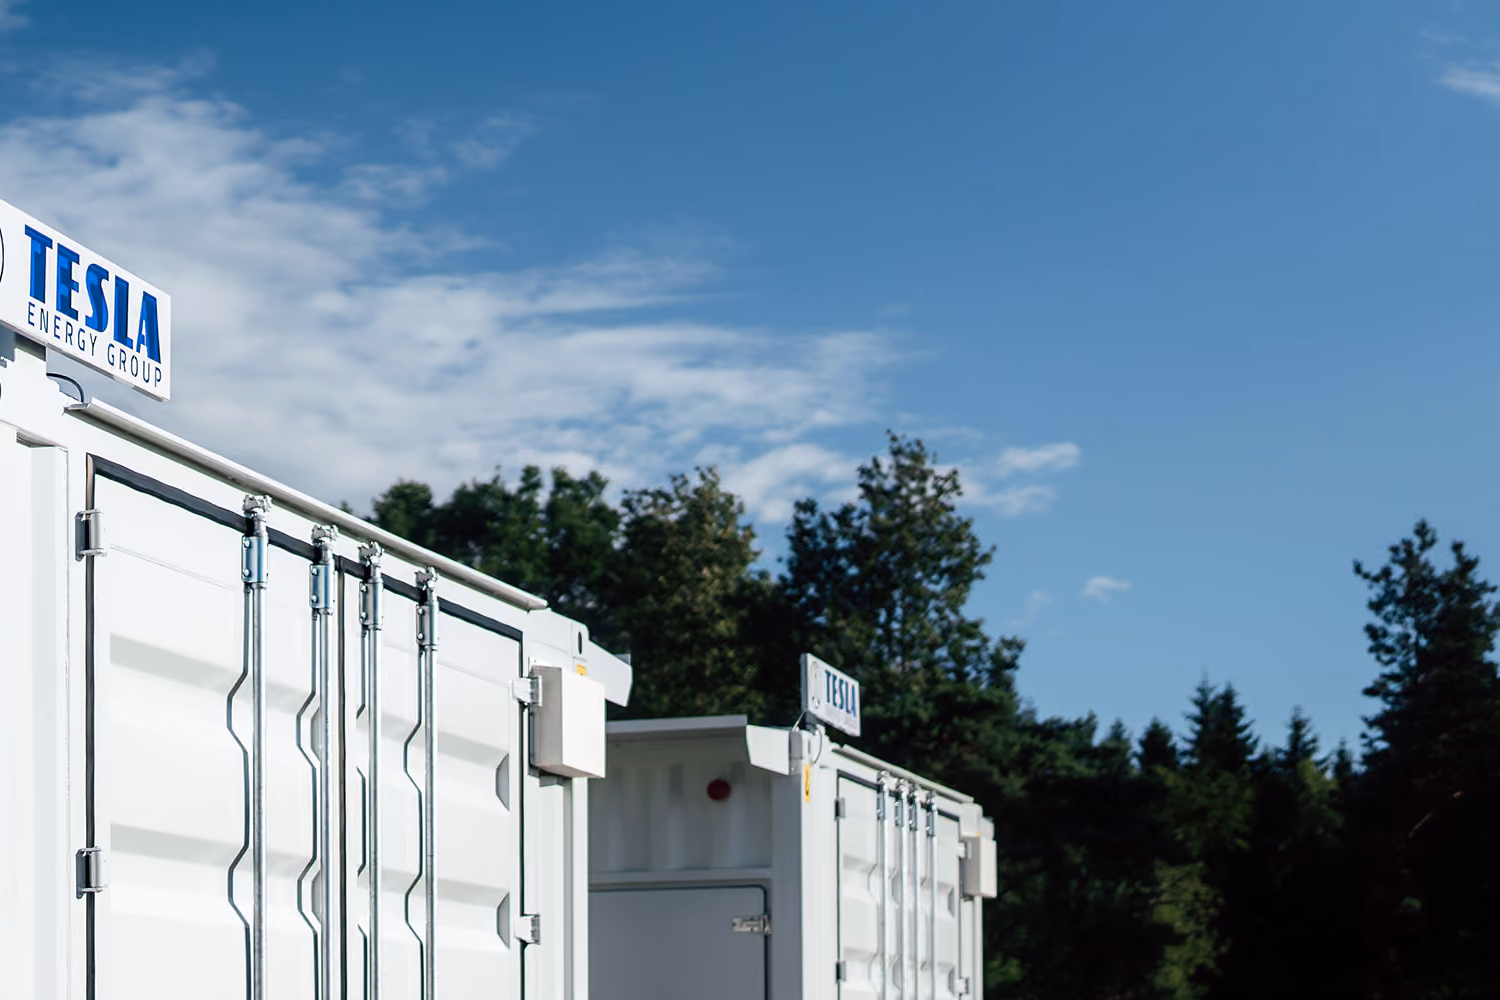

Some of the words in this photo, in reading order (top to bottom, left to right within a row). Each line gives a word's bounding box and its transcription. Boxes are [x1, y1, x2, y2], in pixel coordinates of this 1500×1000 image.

[25, 224, 161, 364] TESLA
[28, 301, 97, 356] ENERGY
[107, 343, 162, 388] GROUP
[825, 669, 857, 718] TESLA
